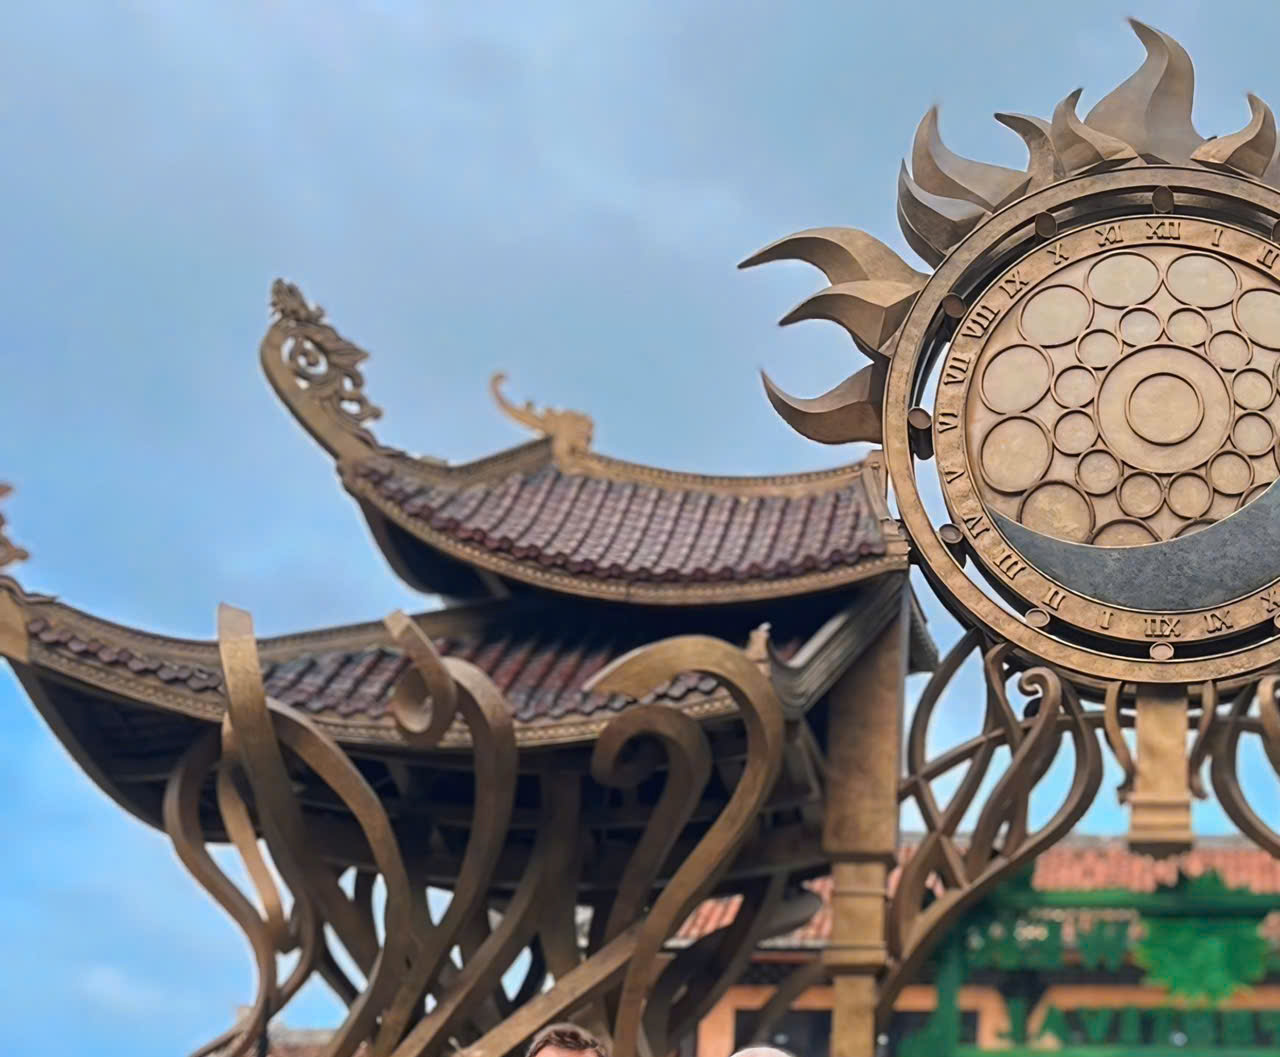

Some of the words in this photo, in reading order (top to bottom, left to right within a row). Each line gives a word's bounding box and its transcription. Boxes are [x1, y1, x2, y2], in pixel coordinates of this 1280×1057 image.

[1095, 225, 1123, 247] XI
[1145, 222, 1181, 240] XII
[1212, 228, 1223, 247] I
[1047, 243, 1069, 265] X
[1257, 246, 1280, 269] II
[999, 270, 1030, 299] IX
[961, 305, 1000, 339] VIII
[943, 356, 971, 386] VII
